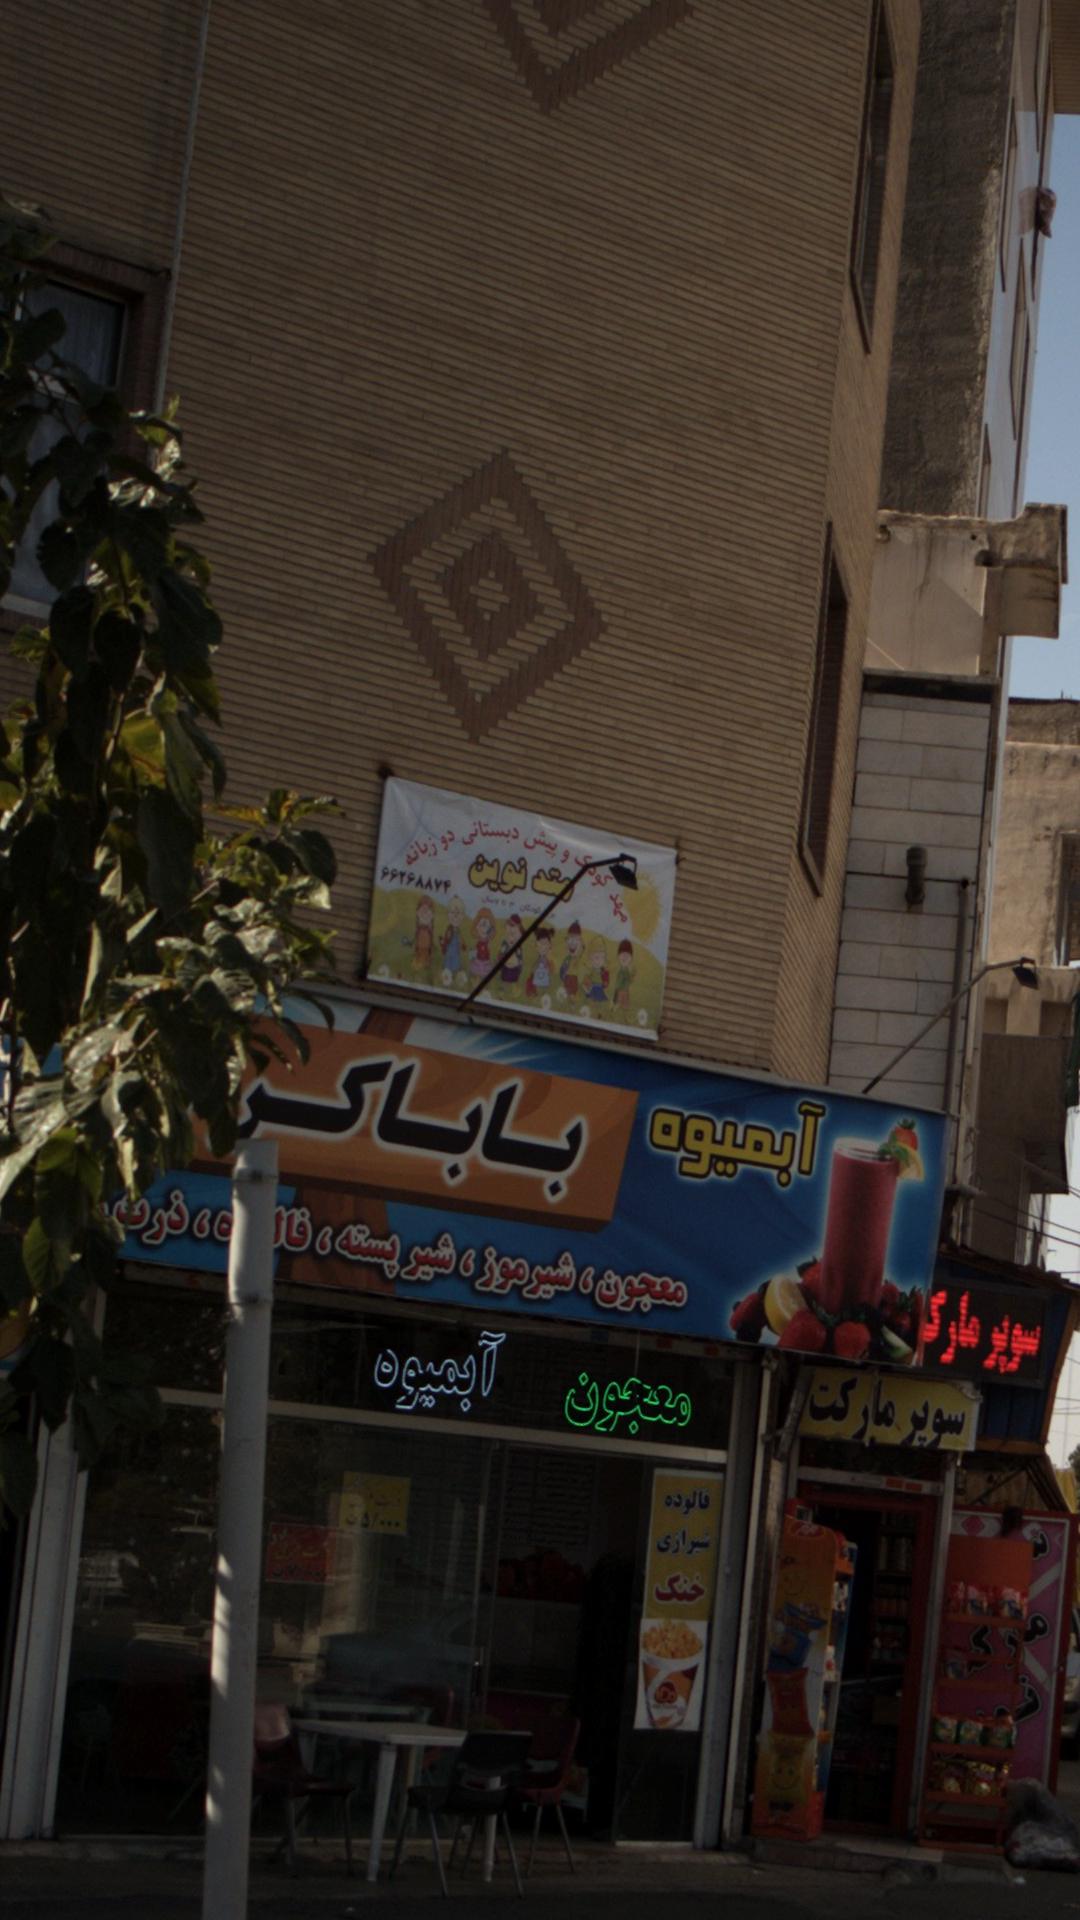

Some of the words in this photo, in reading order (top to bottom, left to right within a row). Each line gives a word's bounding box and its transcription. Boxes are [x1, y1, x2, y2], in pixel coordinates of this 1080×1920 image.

[462, 820, 519, 846] دبستانی
[523, 830, 558, 858] پیش
[560, 848, 570, 863] و
[468, 853, 529, 894] نوین
[649, 1101, 825, 1190] آبمیوه
[920, 1290, 981, 1365] مارک
[373, 1329, 507, 1413] آبمیوه
[563, 1370, 695, 1436] معجون
[808, 1377, 896, 1440] مارکت
[900, 1399, 966, 1449] سوپر
[664, 1490, 710, 1514] فالوده
[657, 1529, 710, 1555] شیرازی
